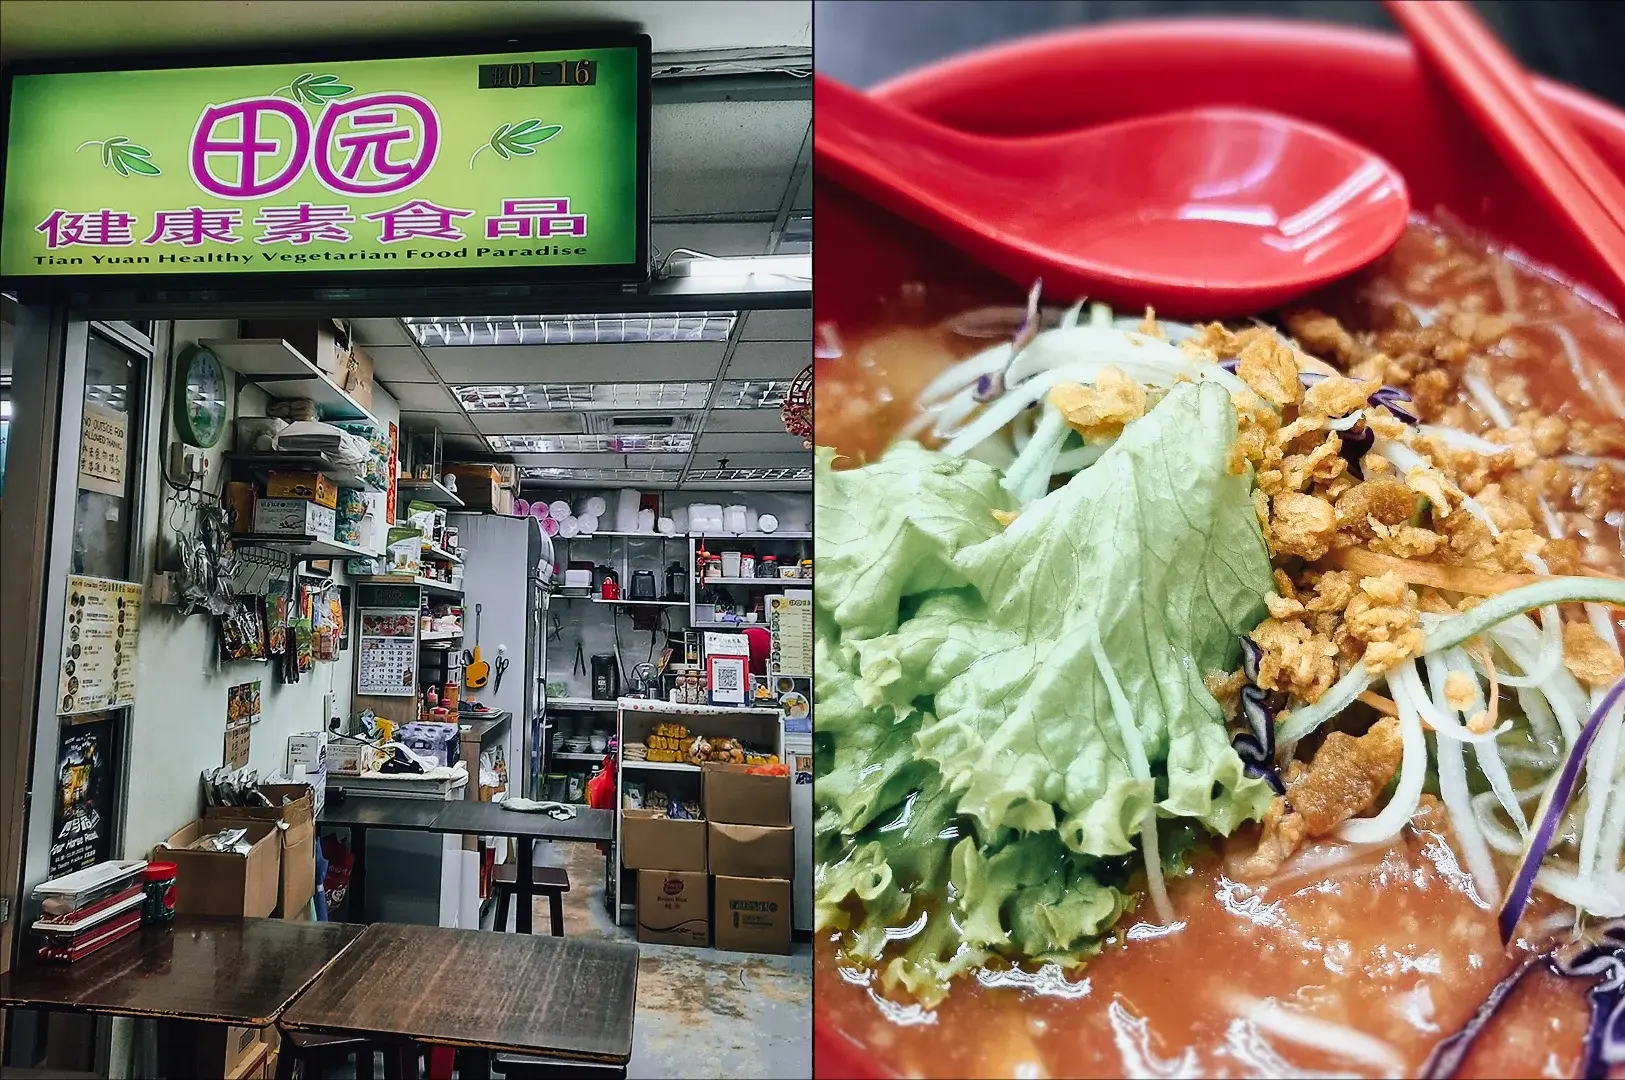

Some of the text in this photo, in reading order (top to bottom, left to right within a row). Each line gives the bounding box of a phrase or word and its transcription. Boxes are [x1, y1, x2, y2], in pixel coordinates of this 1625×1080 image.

[492, 59, 590, 88] #01-16
[190, 93, 439, 198] 田园
[37, 199, 587, 248] 健康素食品
[33, 245, 588, 266] Tian Yuan Healthy Vegetarian Food Paradise
